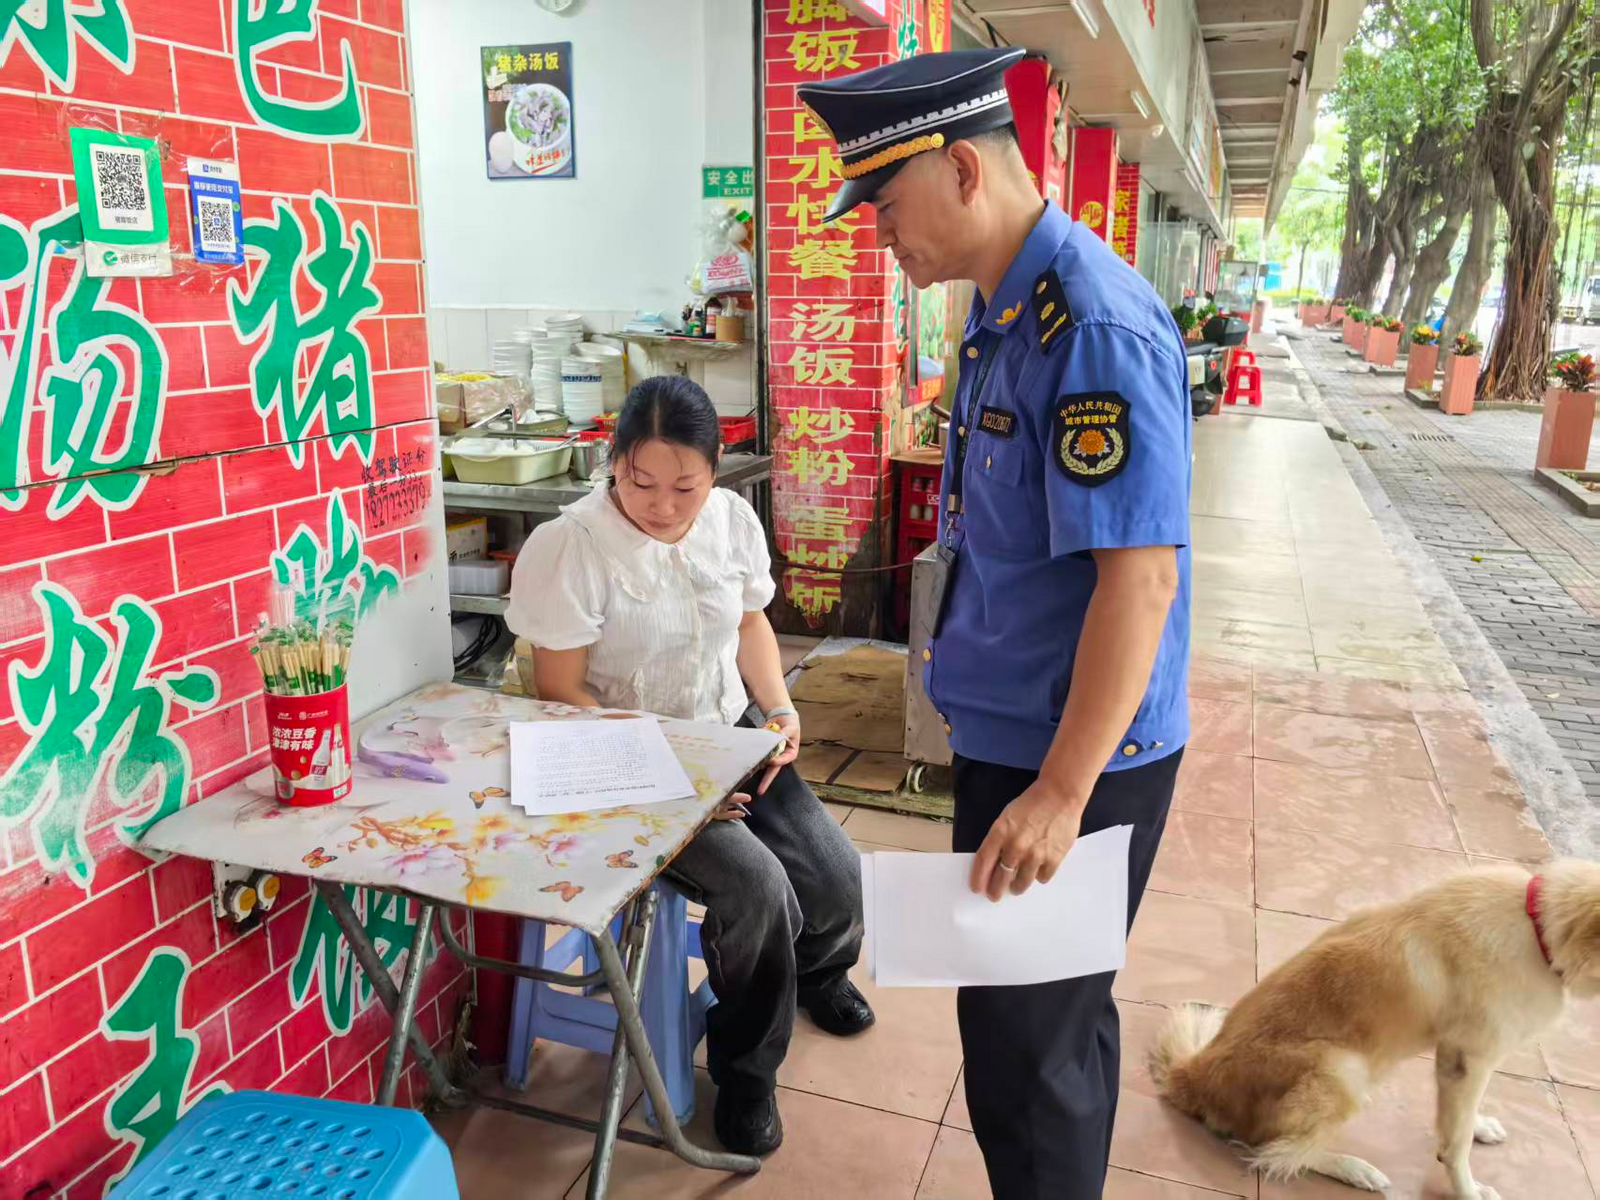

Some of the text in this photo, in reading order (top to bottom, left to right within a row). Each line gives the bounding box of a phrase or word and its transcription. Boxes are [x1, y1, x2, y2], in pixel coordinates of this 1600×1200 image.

[497, 52, 559, 73] 猪杂汤饭
[723, 187, 751, 195] EXIT
[120, 251, 157, 266] 微信支付
[787, 302, 856, 386] 汤饭
[1059, 401, 1122, 418] 中华人民共和国
[1065, 413, 1118, 426] 城市管理协管
[787, 405, 856, 486] 炒粉
